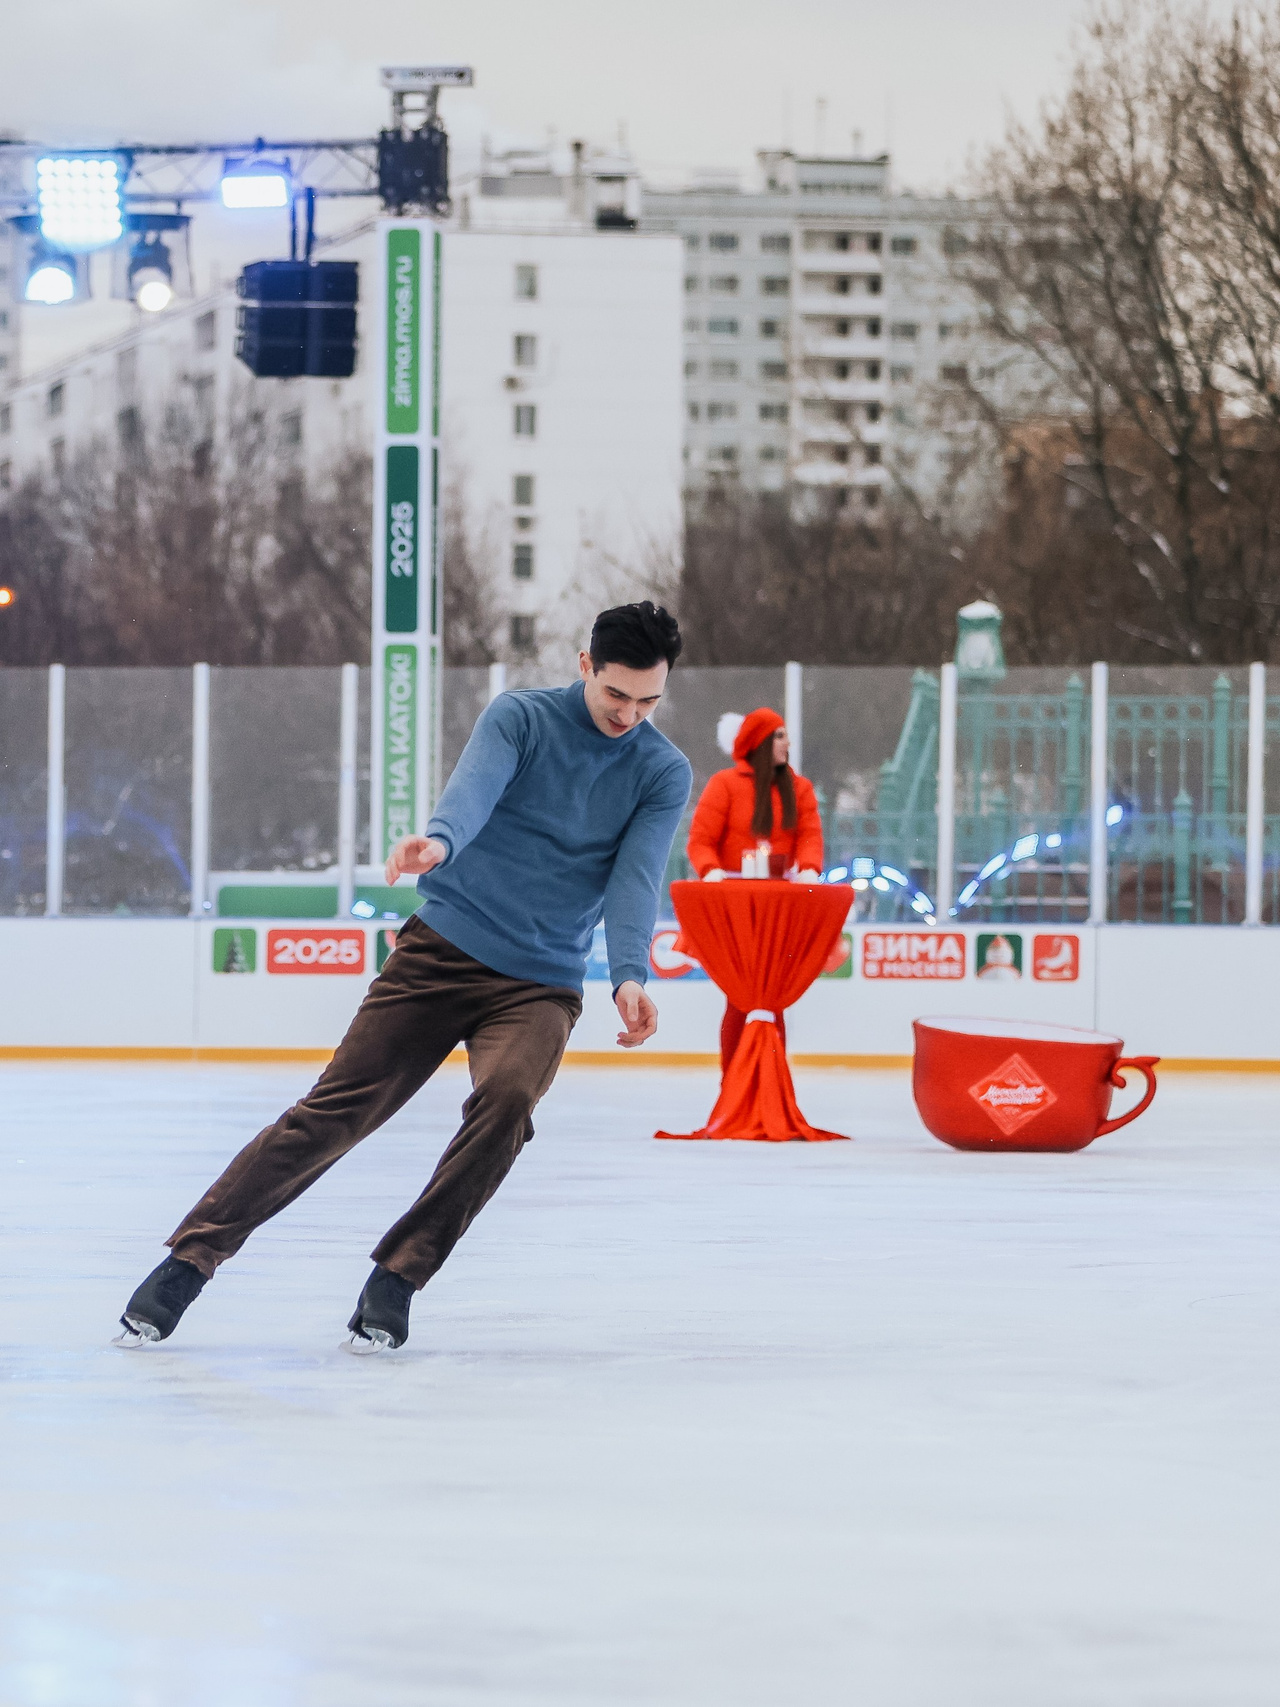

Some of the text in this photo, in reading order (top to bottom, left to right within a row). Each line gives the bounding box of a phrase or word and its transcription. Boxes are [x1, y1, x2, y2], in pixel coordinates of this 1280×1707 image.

[392, 255, 414, 408] zima.mos.ru
[390, 501, 414, 578] 2025
[388, 757, 410, 800] НА
[388, 803, 410, 852] СЕ
[273, 937, 362, 964] 2025
[865, 934, 962, 960] ЗИМА
